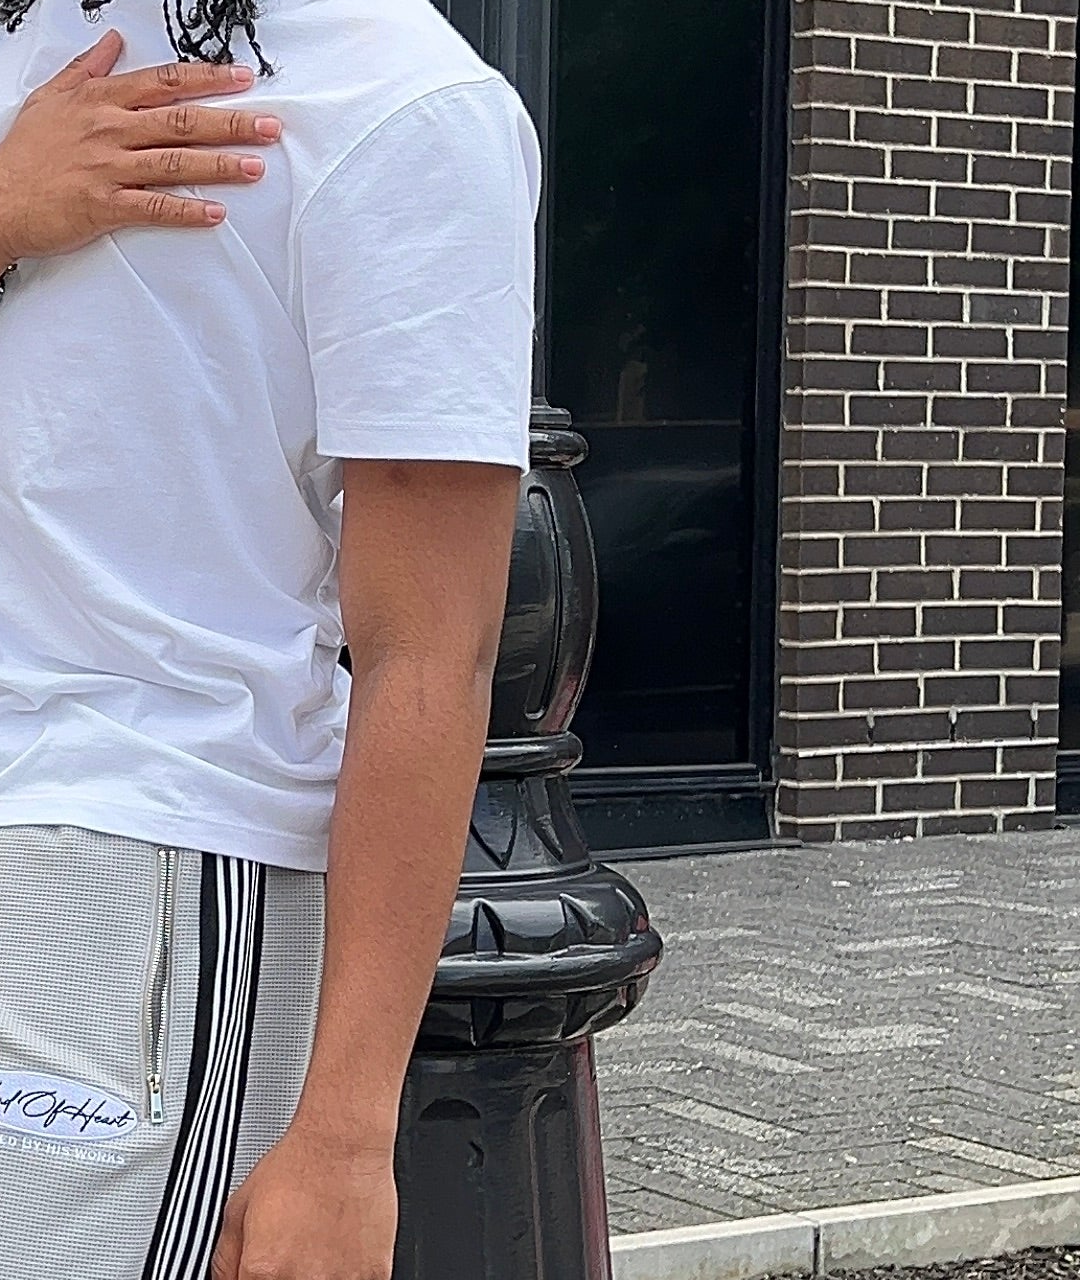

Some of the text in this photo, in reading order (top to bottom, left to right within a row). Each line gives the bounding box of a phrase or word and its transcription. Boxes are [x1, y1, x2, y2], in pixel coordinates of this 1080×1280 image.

[18, 1091, 66, 1128] Of
[62, 1098, 135, 1132] Heart
[21, 1137, 41, 1151] BY
[44, 1142, 71, 1157] HIS
[73, 1148, 125, 1165] WORKS
